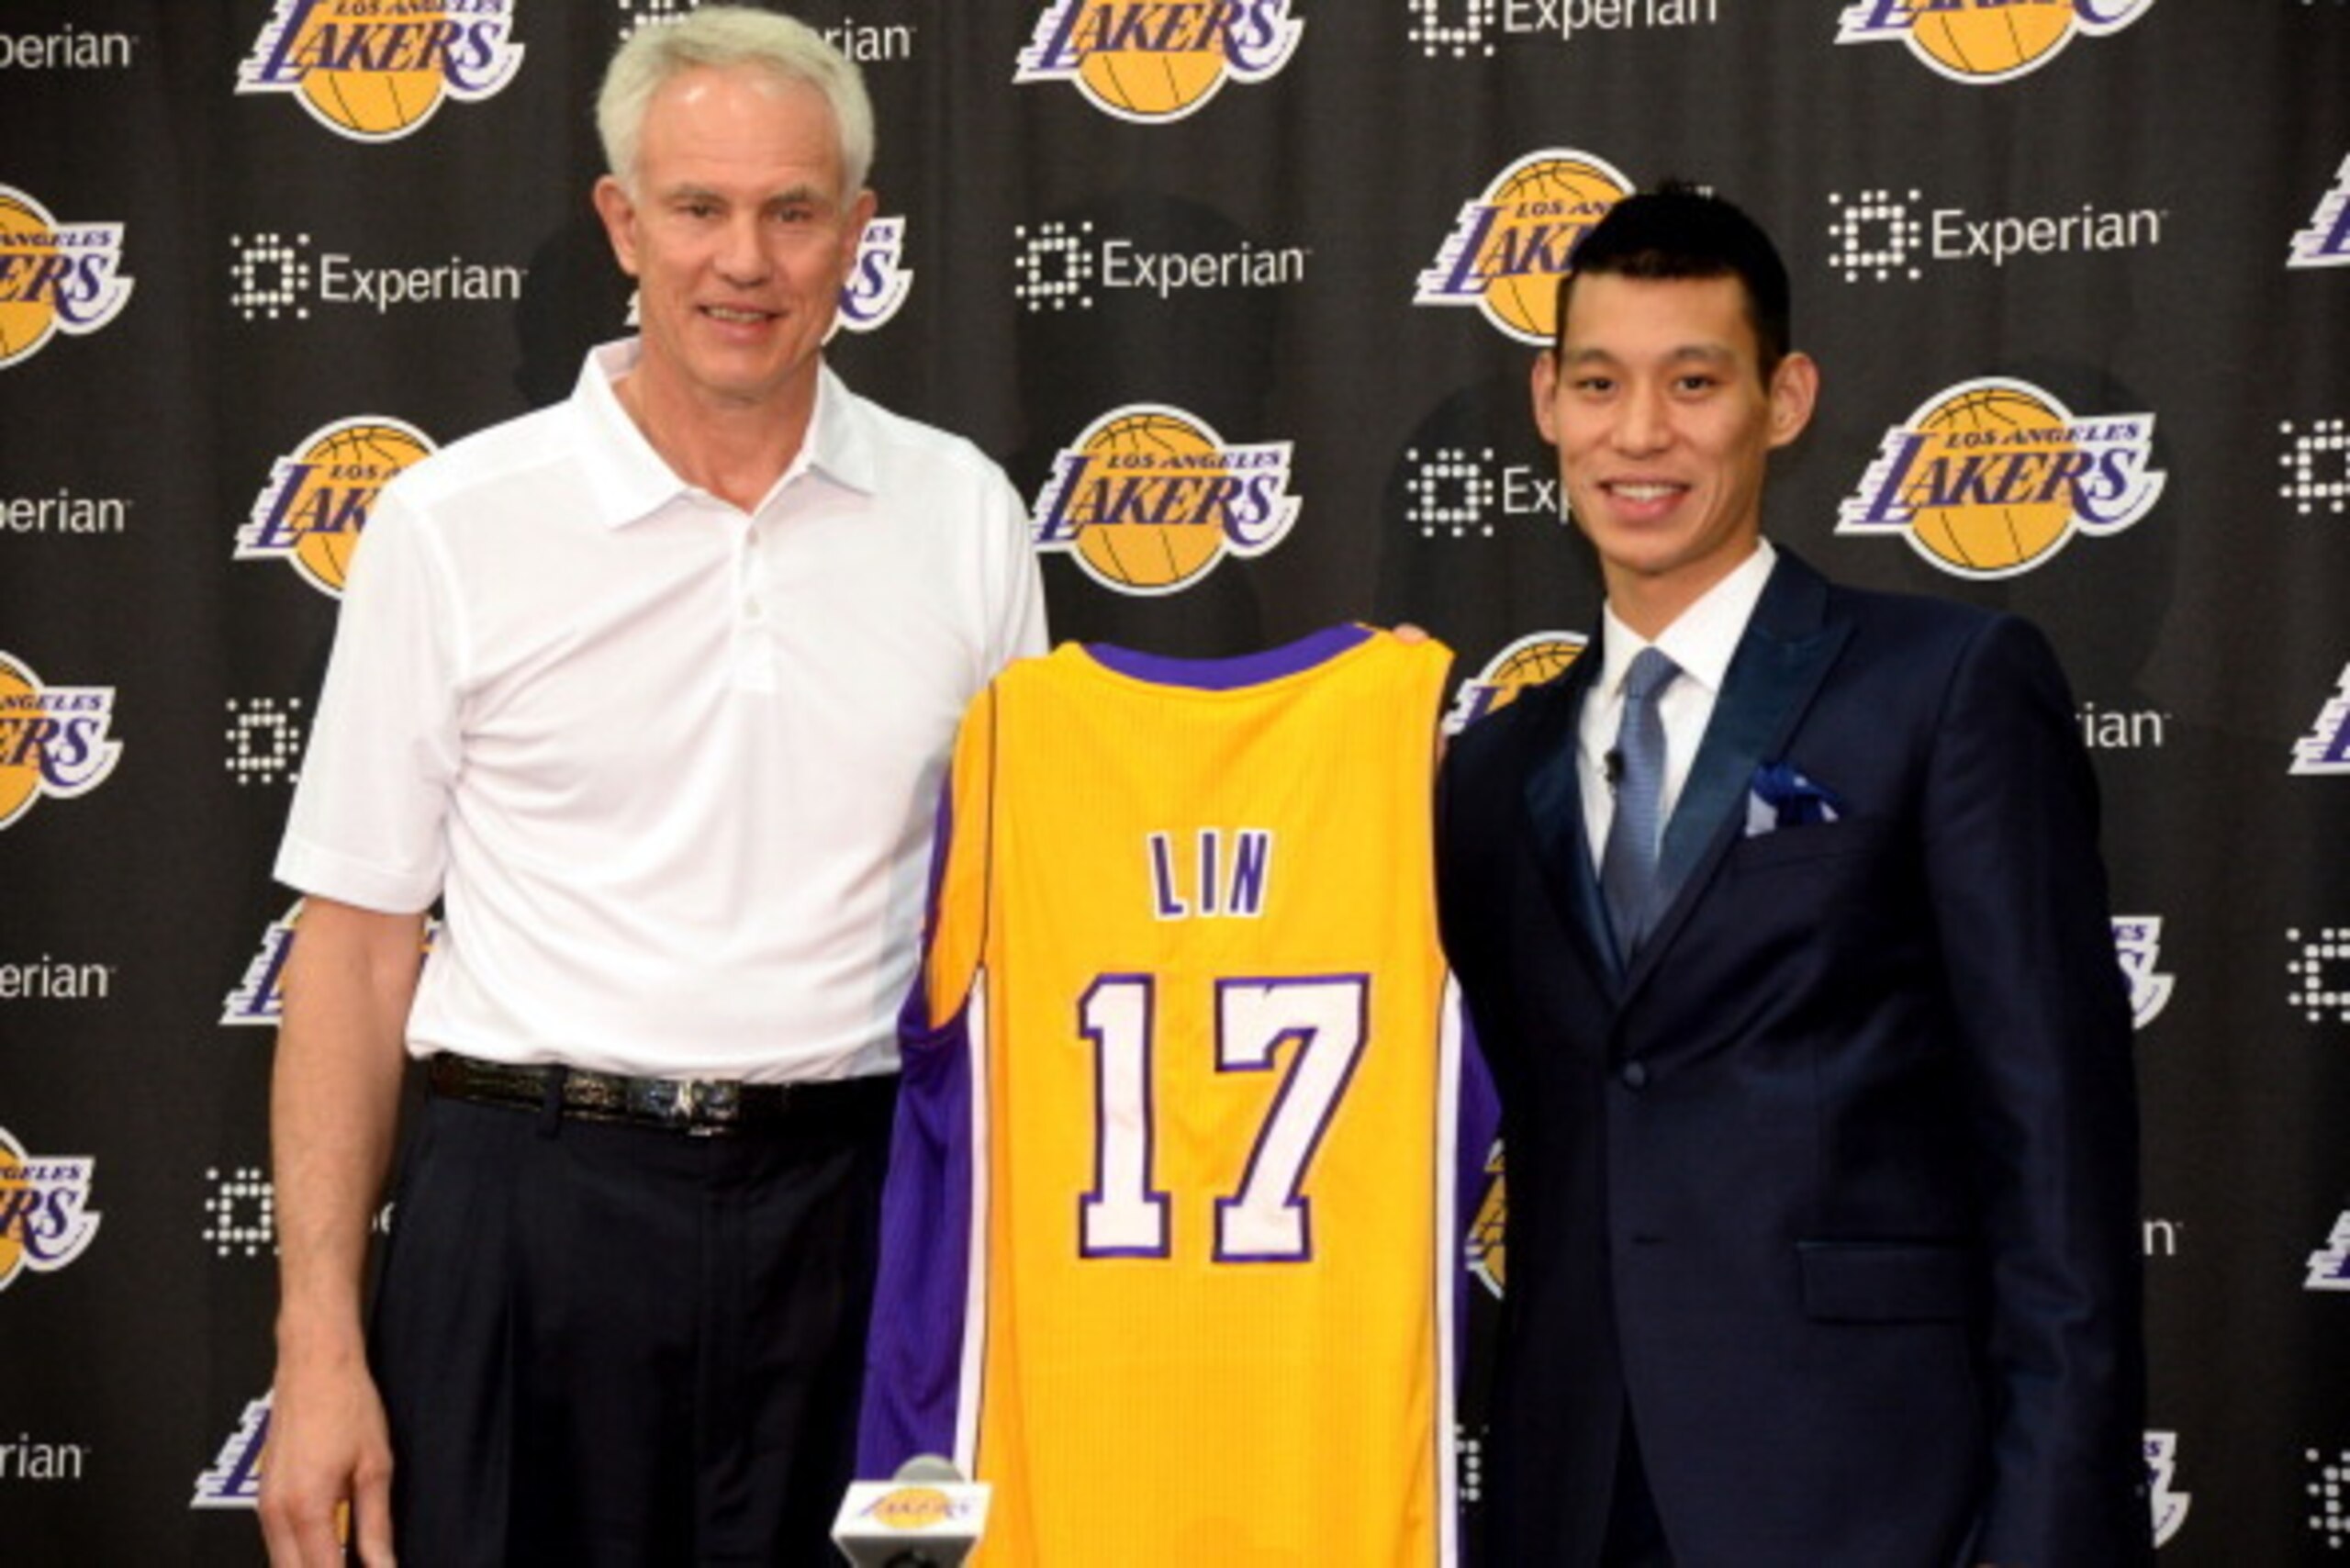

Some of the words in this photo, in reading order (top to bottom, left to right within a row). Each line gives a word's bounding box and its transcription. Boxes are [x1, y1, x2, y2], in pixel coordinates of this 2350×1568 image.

[246, 0, 512, 90] LAKERS
[1027, 0, 1291, 71] LAKERS
[1516, 200, 1564, 218] LOS
[1932, 205, 2160, 266] Experian
[1102, 240, 1304, 299] Experian
[1428, 205, 1600, 296] LAK
[319, 253, 521, 313] Experian
[1105, 453, 1157, 470] LOS
[1160, 448, 1281, 469] ANGELES
[1943, 429, 1997, 449] LOS
[2002, 421, 2141, 446] ANGELES
[330, 464, 378, 480] LOS
[1032, 455, 1289, 547] LAKERS
[1849, 432, 2151, 525] LAKERS
[0, 487, 125, 532] erian
[1147, 829, 1270, 919] LIN
[1077, 972, 1371, 1263] 17
